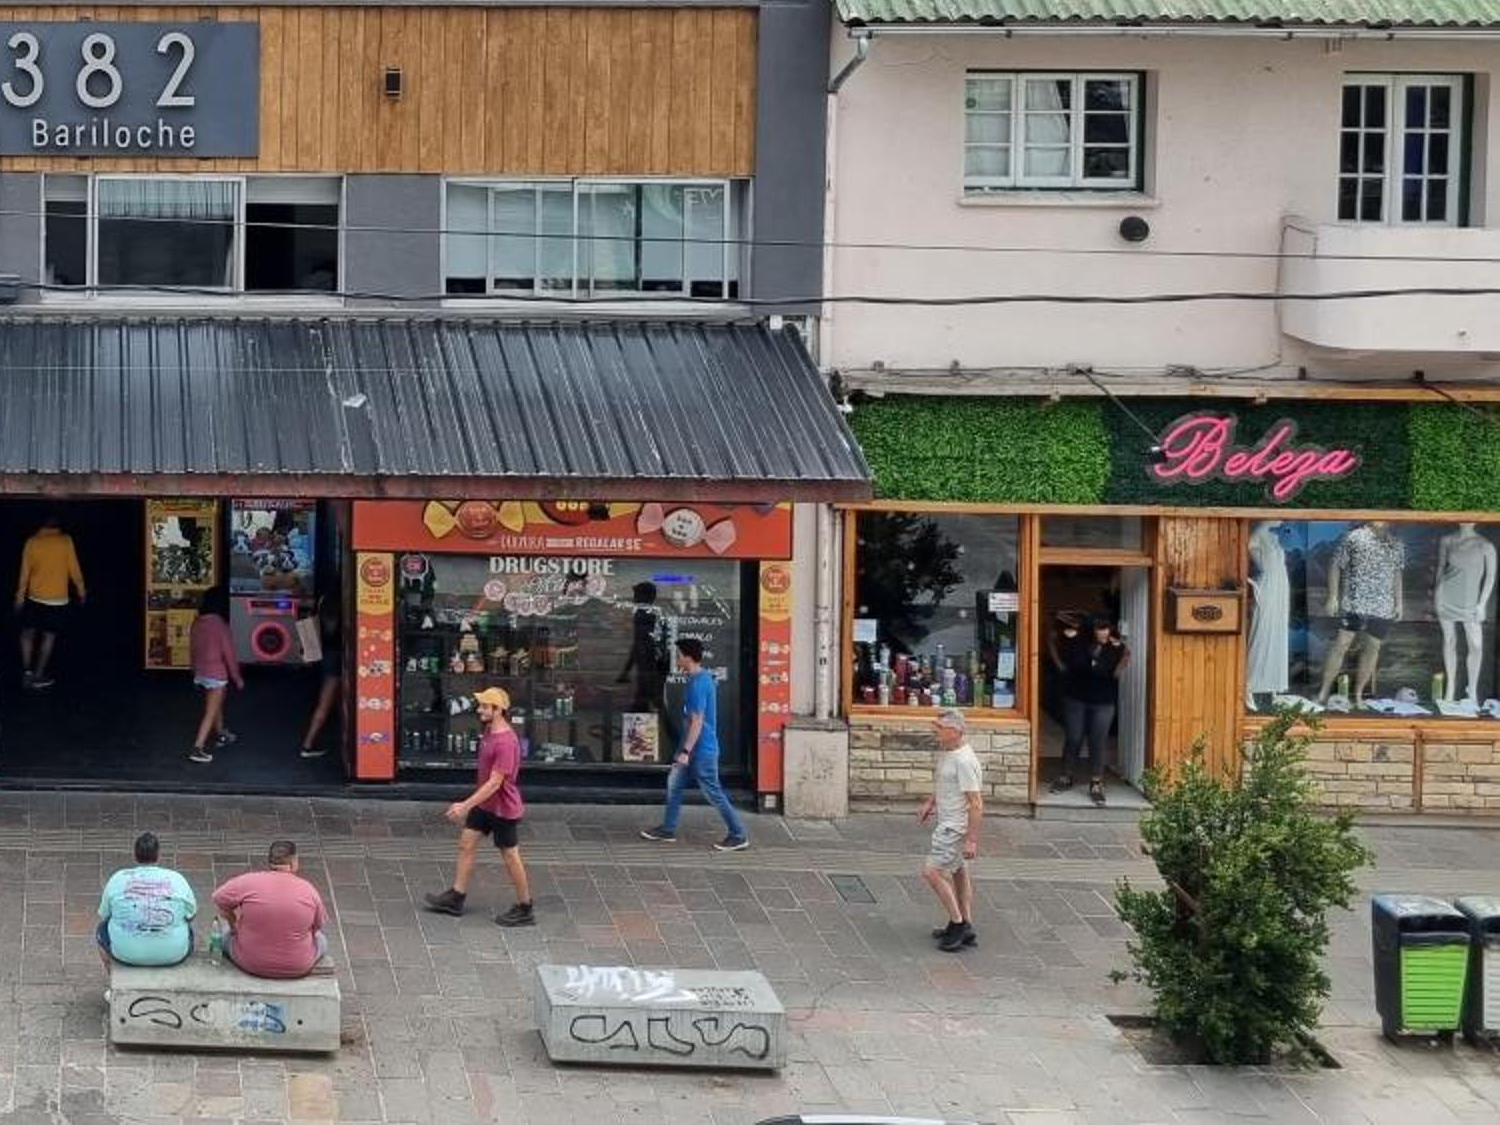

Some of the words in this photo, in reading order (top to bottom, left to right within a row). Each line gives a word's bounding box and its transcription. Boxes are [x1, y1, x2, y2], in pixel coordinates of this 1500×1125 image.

[32, 118, 196, 147] Bariloche
[1155, 416, 1356, 497] Beleza
[489, 556, 615, 576] DRUGSTORE
